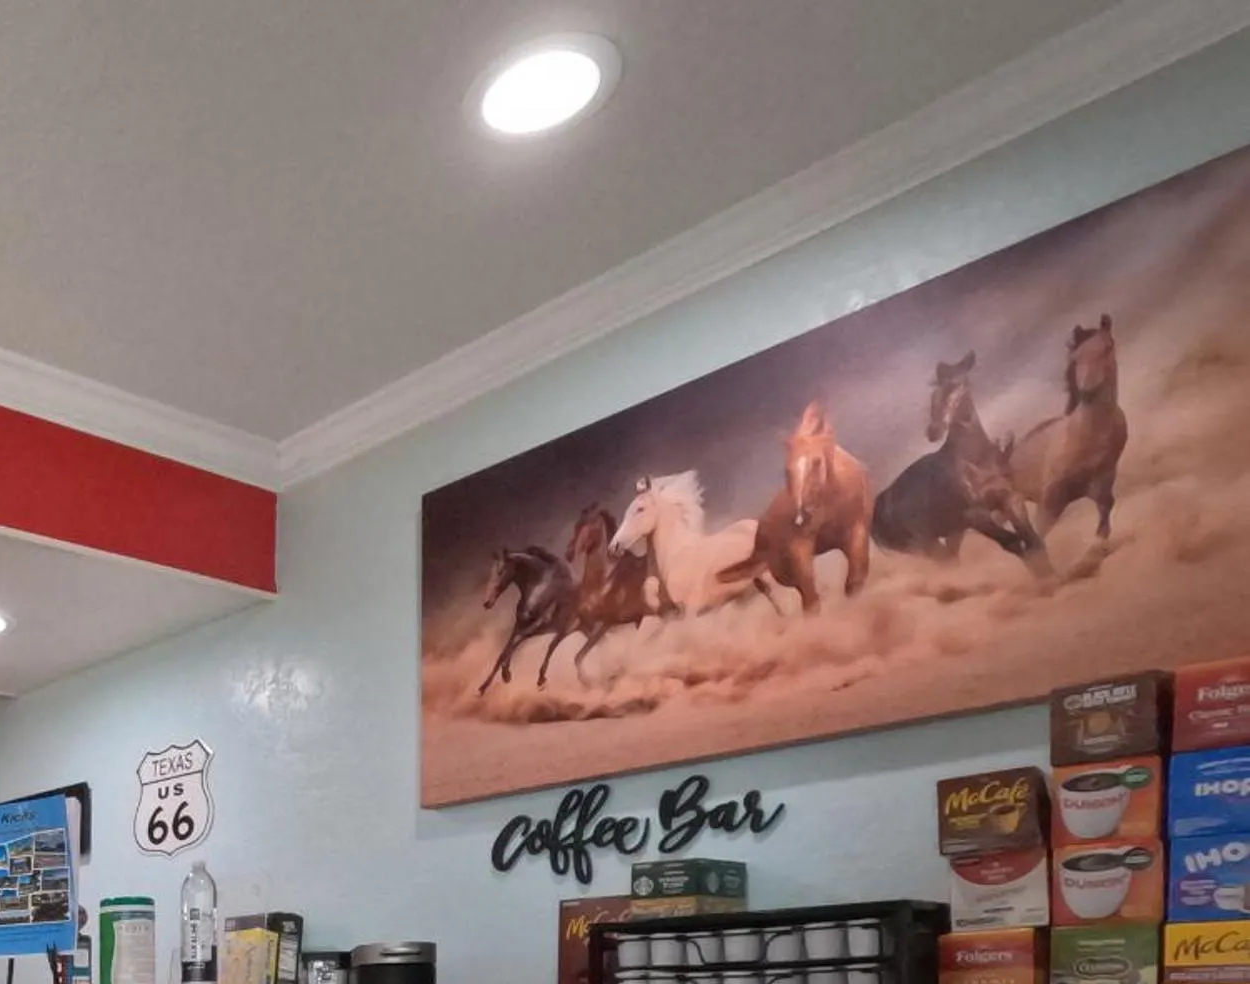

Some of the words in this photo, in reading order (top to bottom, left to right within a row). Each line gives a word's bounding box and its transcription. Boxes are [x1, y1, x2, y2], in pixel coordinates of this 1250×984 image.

[152, 752, 193, 776] TEXAS
[157, 782, 184, 799] US
[148, 801, 194, 845] 66
[658, 775, 785, 853] Bar
[1185, 842, 1250, 873] IHO
[956, 950, 1013, 964] Folgers
[1174, 930, 1250, 962] McCa
